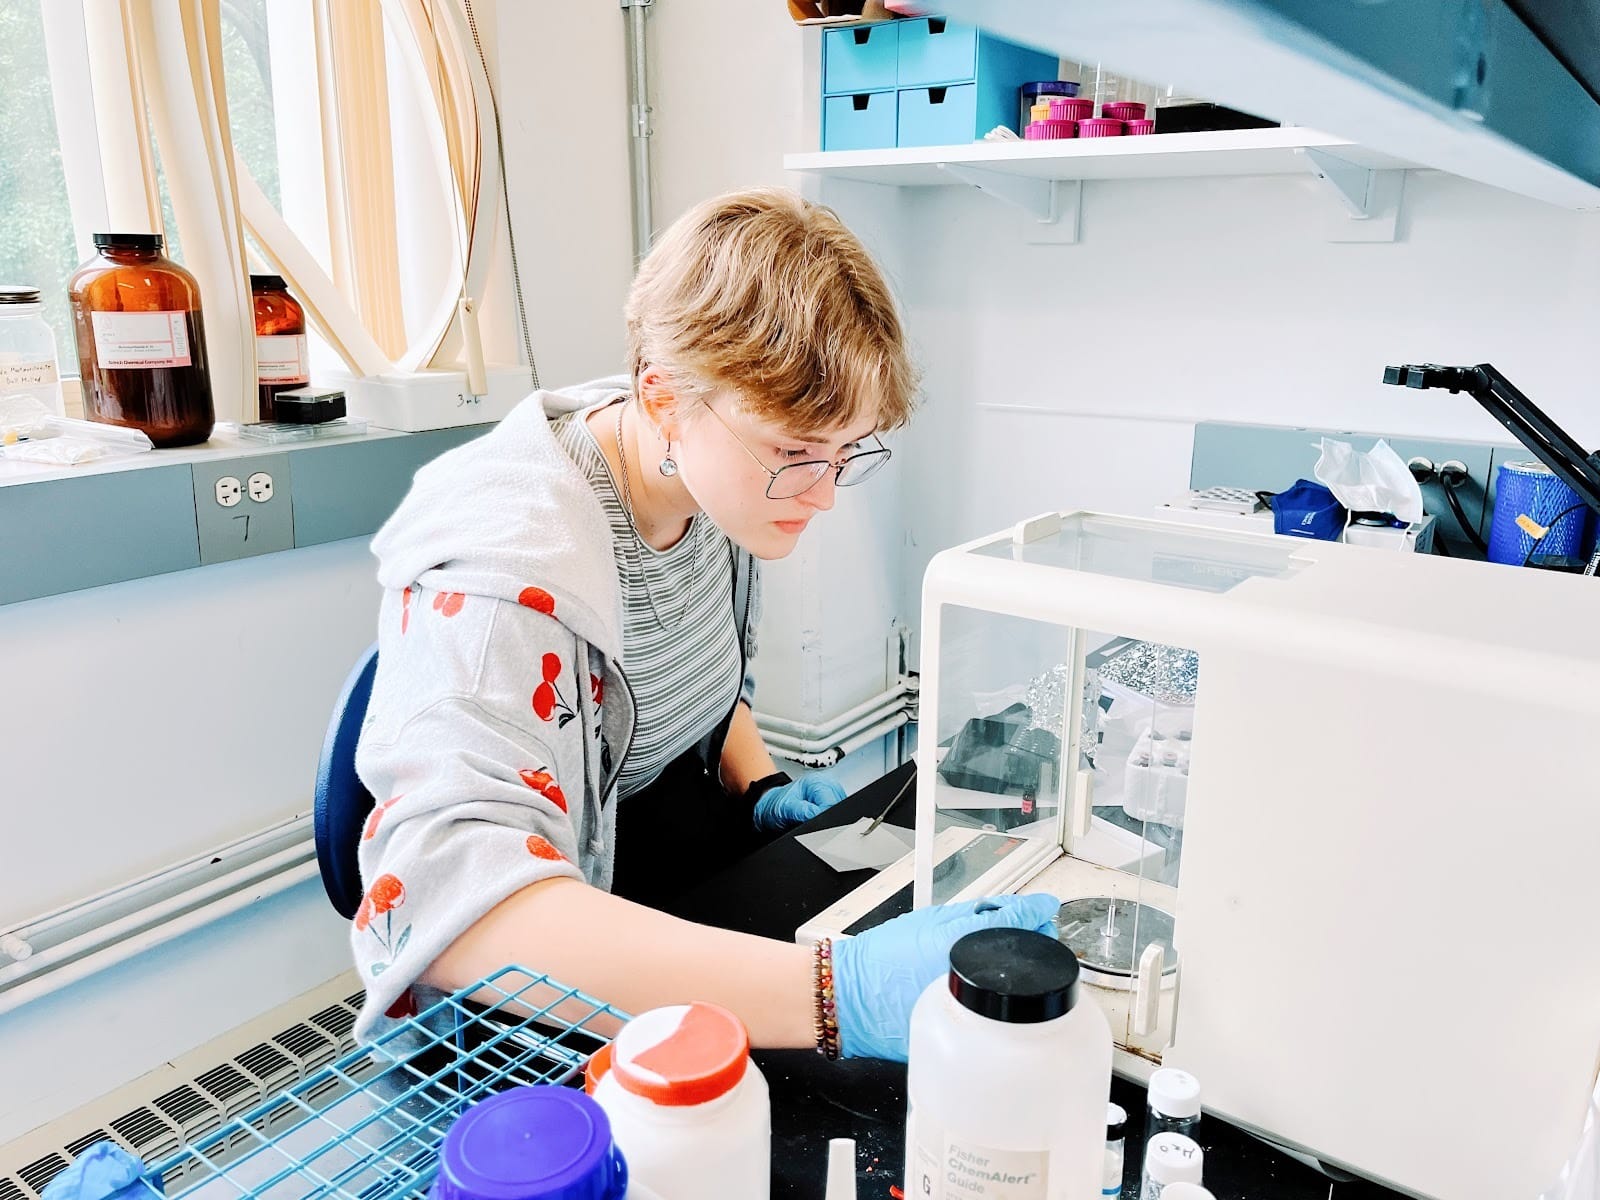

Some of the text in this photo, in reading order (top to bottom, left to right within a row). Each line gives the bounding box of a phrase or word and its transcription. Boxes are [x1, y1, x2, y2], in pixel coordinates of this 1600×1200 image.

[232, 515, 250, 542] 7
[948, 1144, 990, 1167] Fisher
[947, 1172, 985, 1194] Guide
